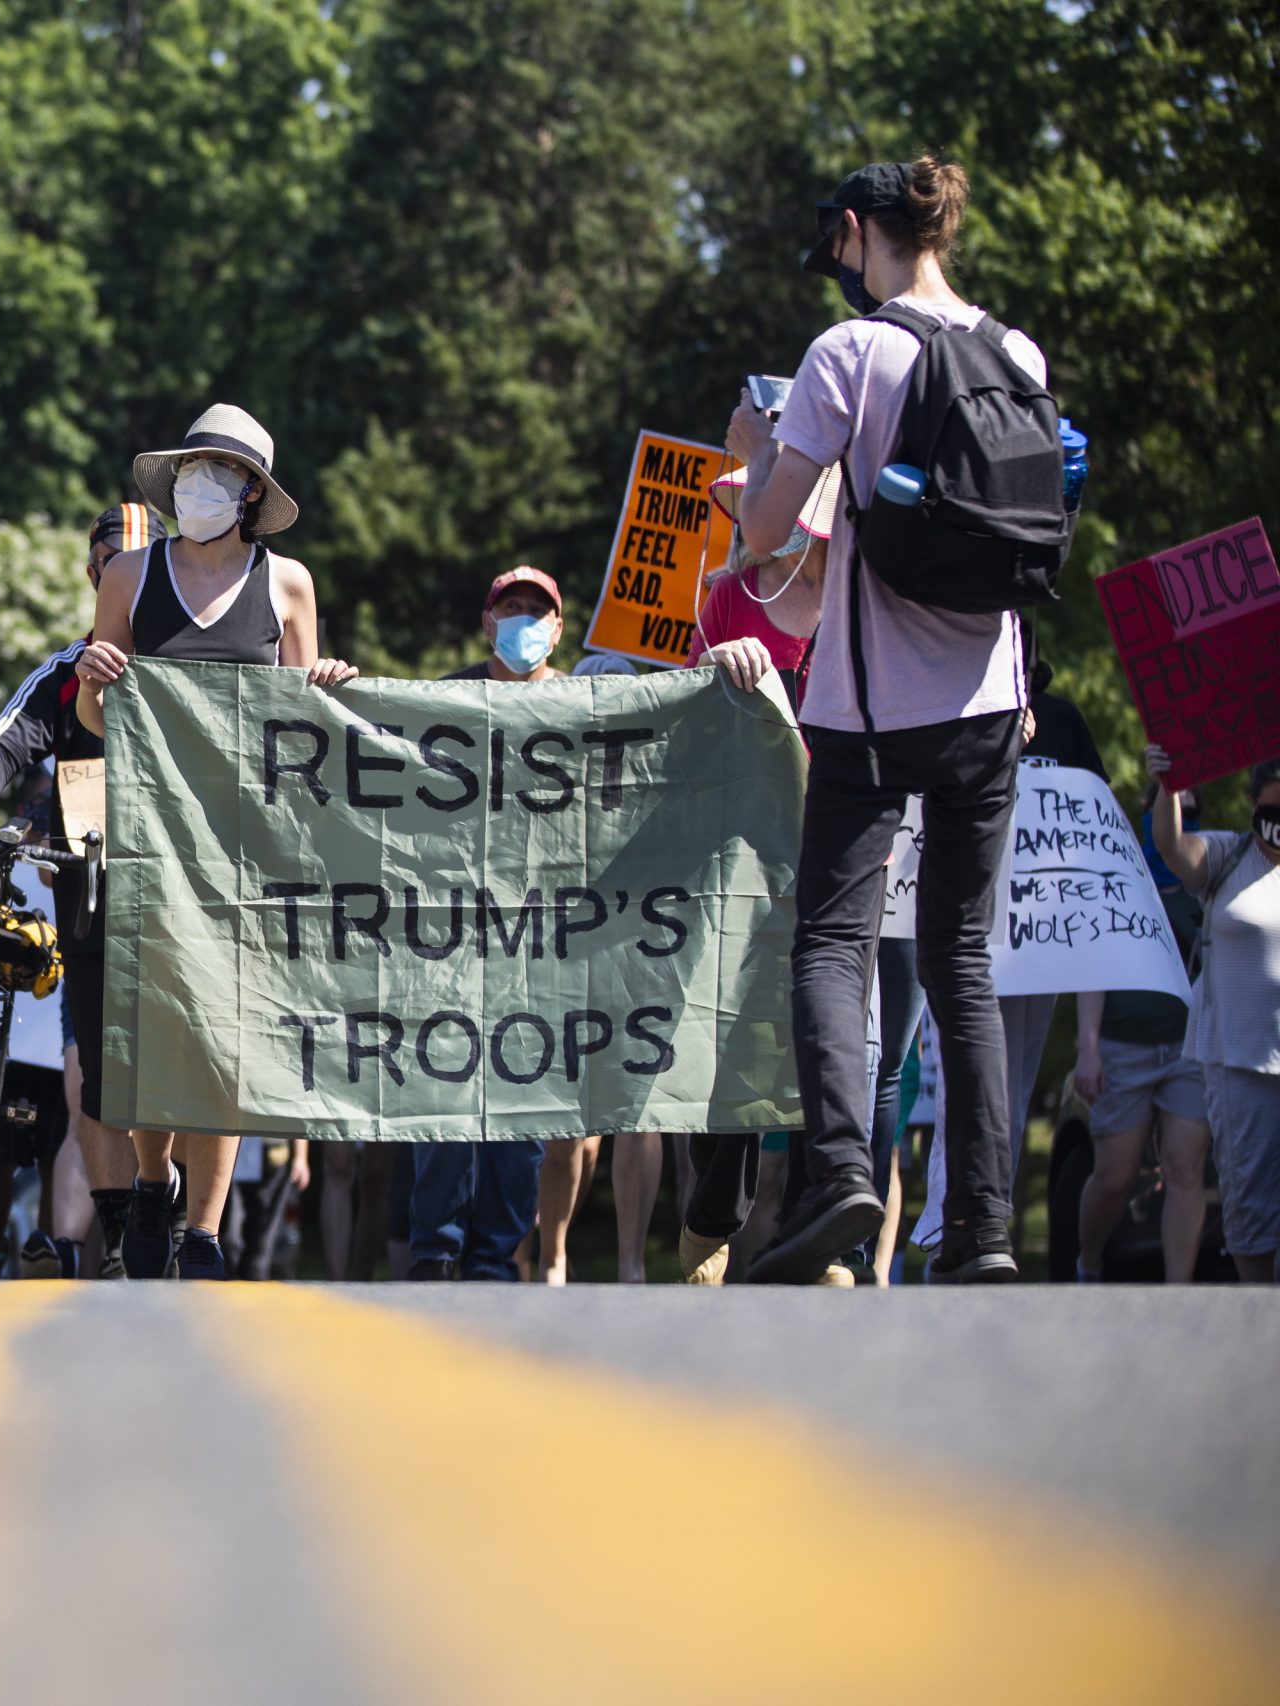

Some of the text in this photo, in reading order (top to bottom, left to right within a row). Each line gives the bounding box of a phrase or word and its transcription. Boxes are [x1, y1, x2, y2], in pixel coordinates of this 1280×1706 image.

[641, 444, 707, 492] MAKE
[634, 485, 710, 534] TRUMP
[622, 525, 678, 571] FEEL
[613, 566, 664, 609] SAD.
[639, 612, 698, 657] VOTE
[262, 718, 654, 815] RESIST
[1032, 788, 1091, 825] THE
[1010, 876, 1132, 903] WE'RE AT
[262, 881, 691, 961] TRUMP'S
[1008, 911, 1100, 951] WOLF'S
[279, 1005, 677, 1092] TROOPS
